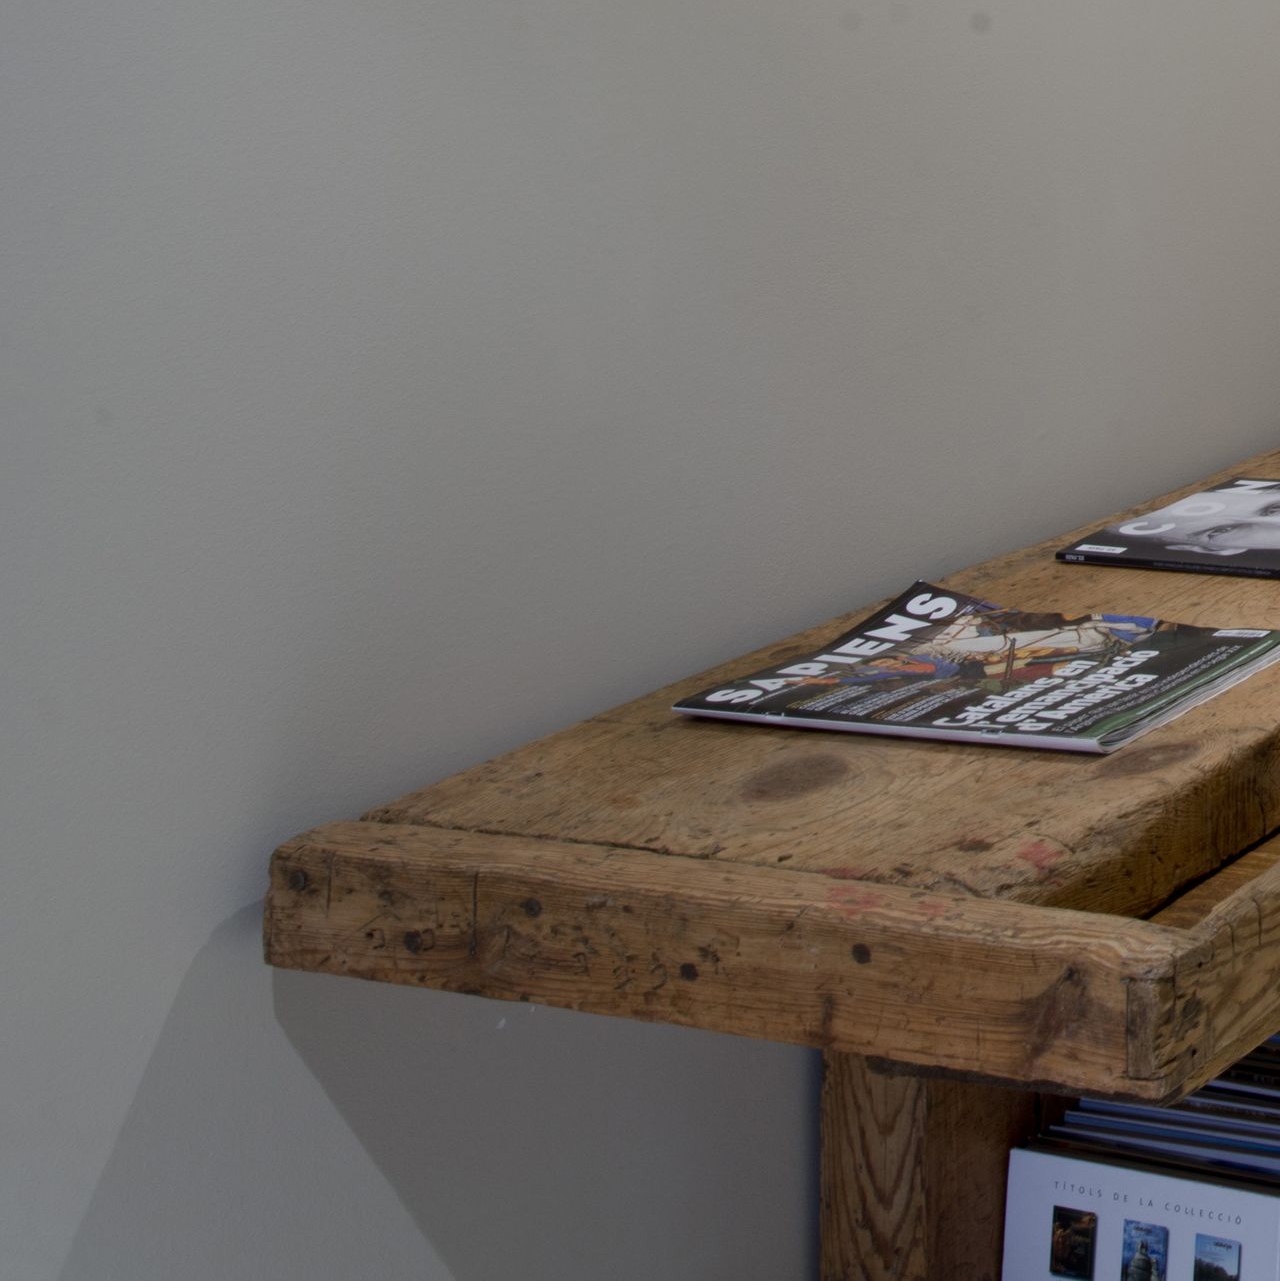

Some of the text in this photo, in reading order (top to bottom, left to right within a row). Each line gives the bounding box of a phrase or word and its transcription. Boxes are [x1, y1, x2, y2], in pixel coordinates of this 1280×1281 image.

[705, 592, 957, 704] SAPIENS
[931, 677, 1064, 728] Catalans
[1053, 660, 1099, 677] en
[1054, 1180, 1103, 1198] TÍTOLS
[1113, 1192, 1129, 1203] DE
[1139, 1197, 1154, 1207] LA
